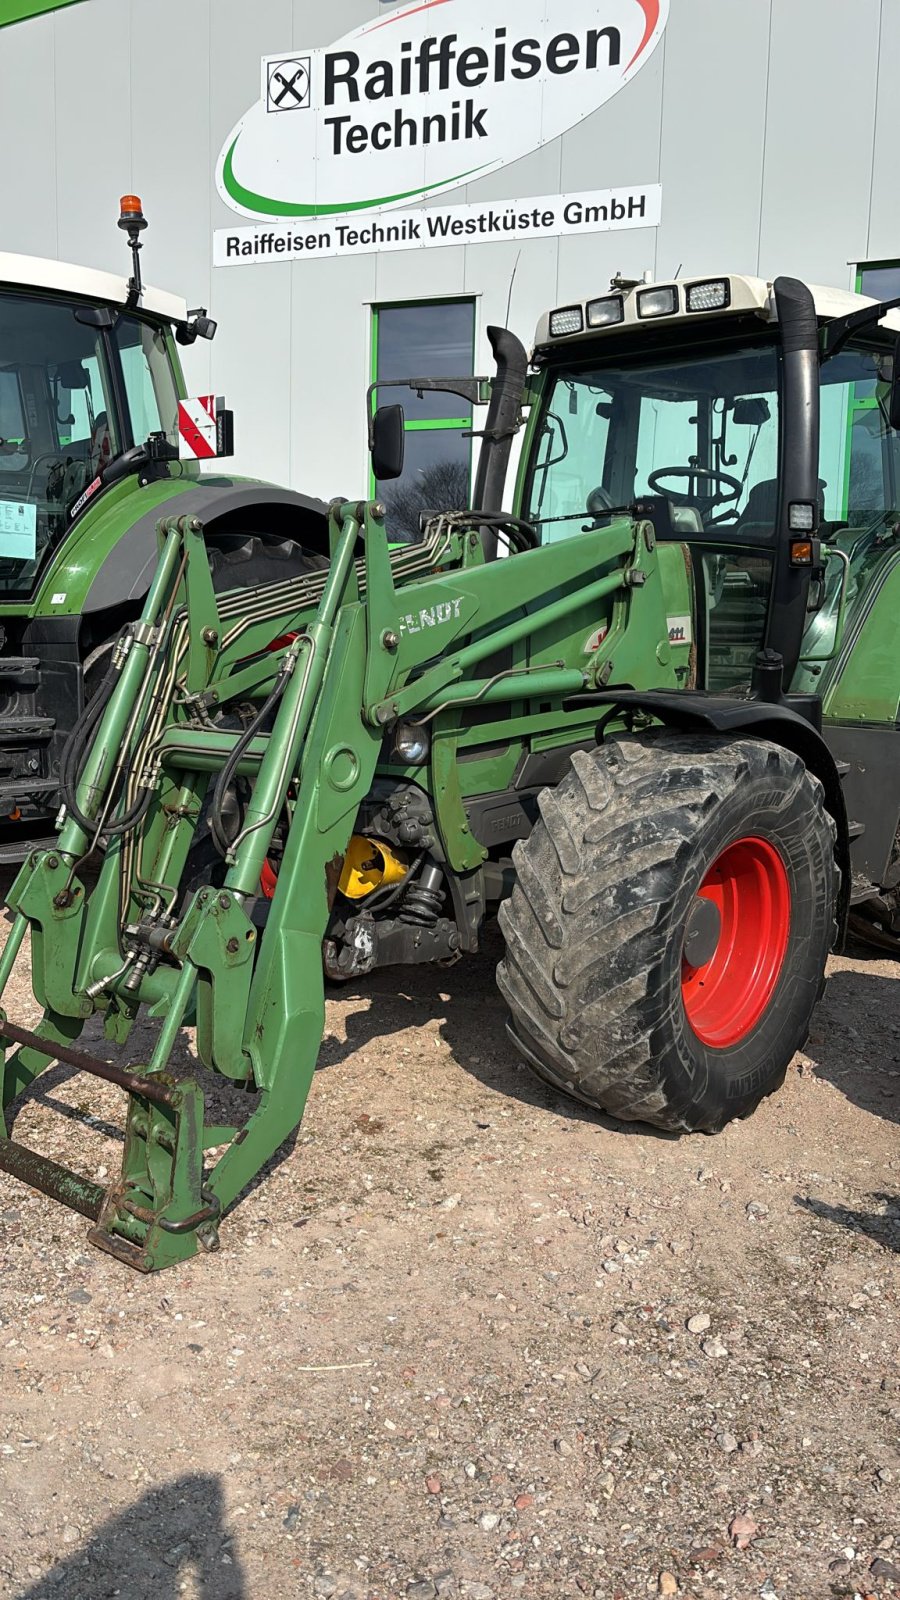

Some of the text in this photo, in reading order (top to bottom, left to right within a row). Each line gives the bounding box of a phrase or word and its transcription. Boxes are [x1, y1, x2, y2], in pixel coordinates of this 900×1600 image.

[324, 26, 621, 106] Raiffeisen
[324, 98, 489, 155] Technik
[226, 195, 646, 257] Raiffeisen Technik Westküste GmbH
